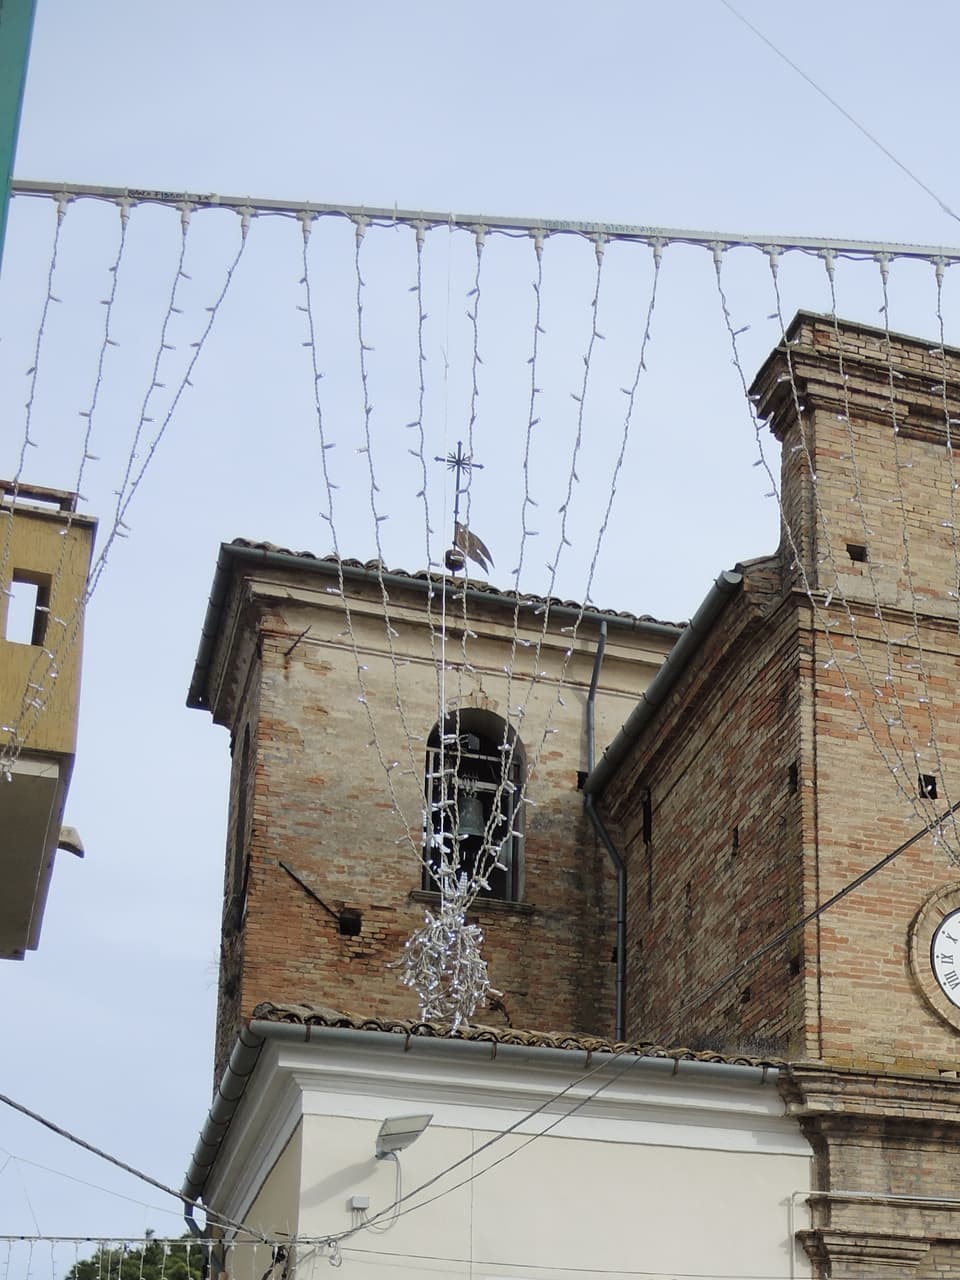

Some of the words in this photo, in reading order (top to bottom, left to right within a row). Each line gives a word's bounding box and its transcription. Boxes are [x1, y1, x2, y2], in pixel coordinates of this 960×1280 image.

[945, 932, 958, 944] X
[940, 953, 954, 965] IX
[944, 970, 960, 990] VIII
